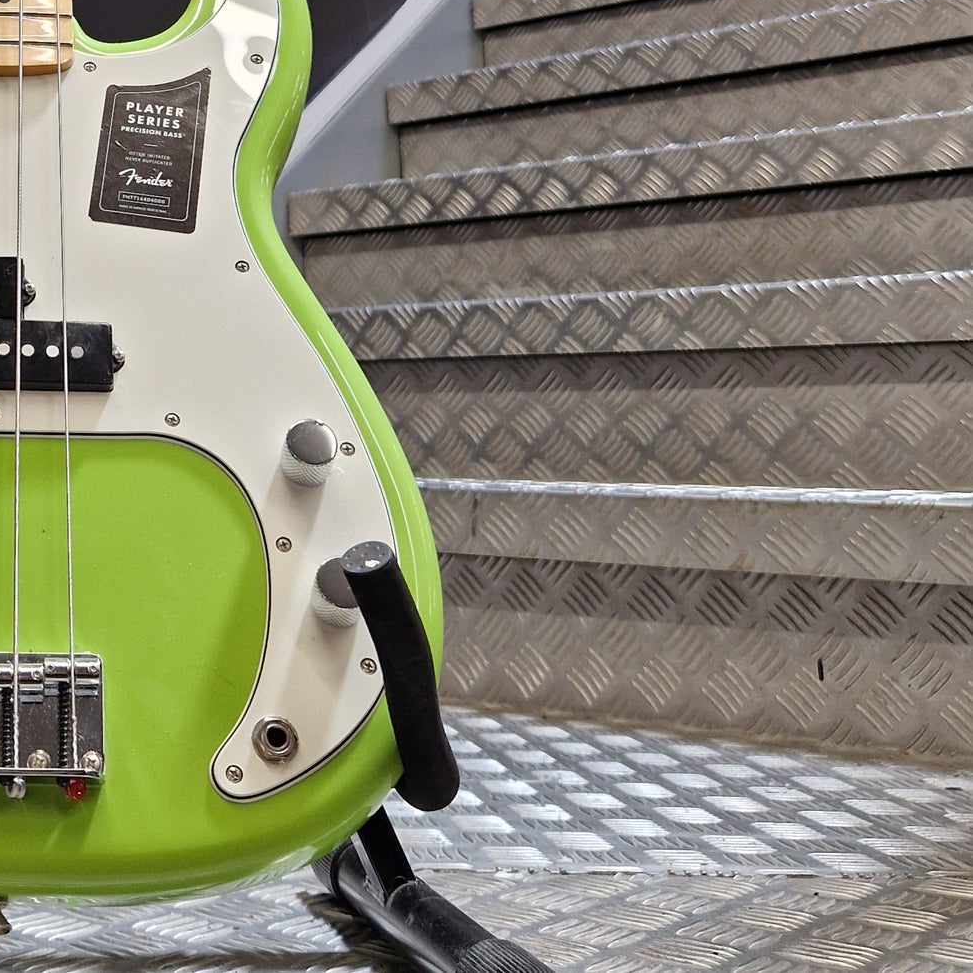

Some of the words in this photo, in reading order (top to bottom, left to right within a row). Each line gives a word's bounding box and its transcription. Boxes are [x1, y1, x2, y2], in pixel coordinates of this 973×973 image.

[126, 101, 184, 117] PLAYER
[127, 114, 180, 129] SERIES
[120, 125, 161, 136] PRECISION
[118, 167, 174, 188] Fender
